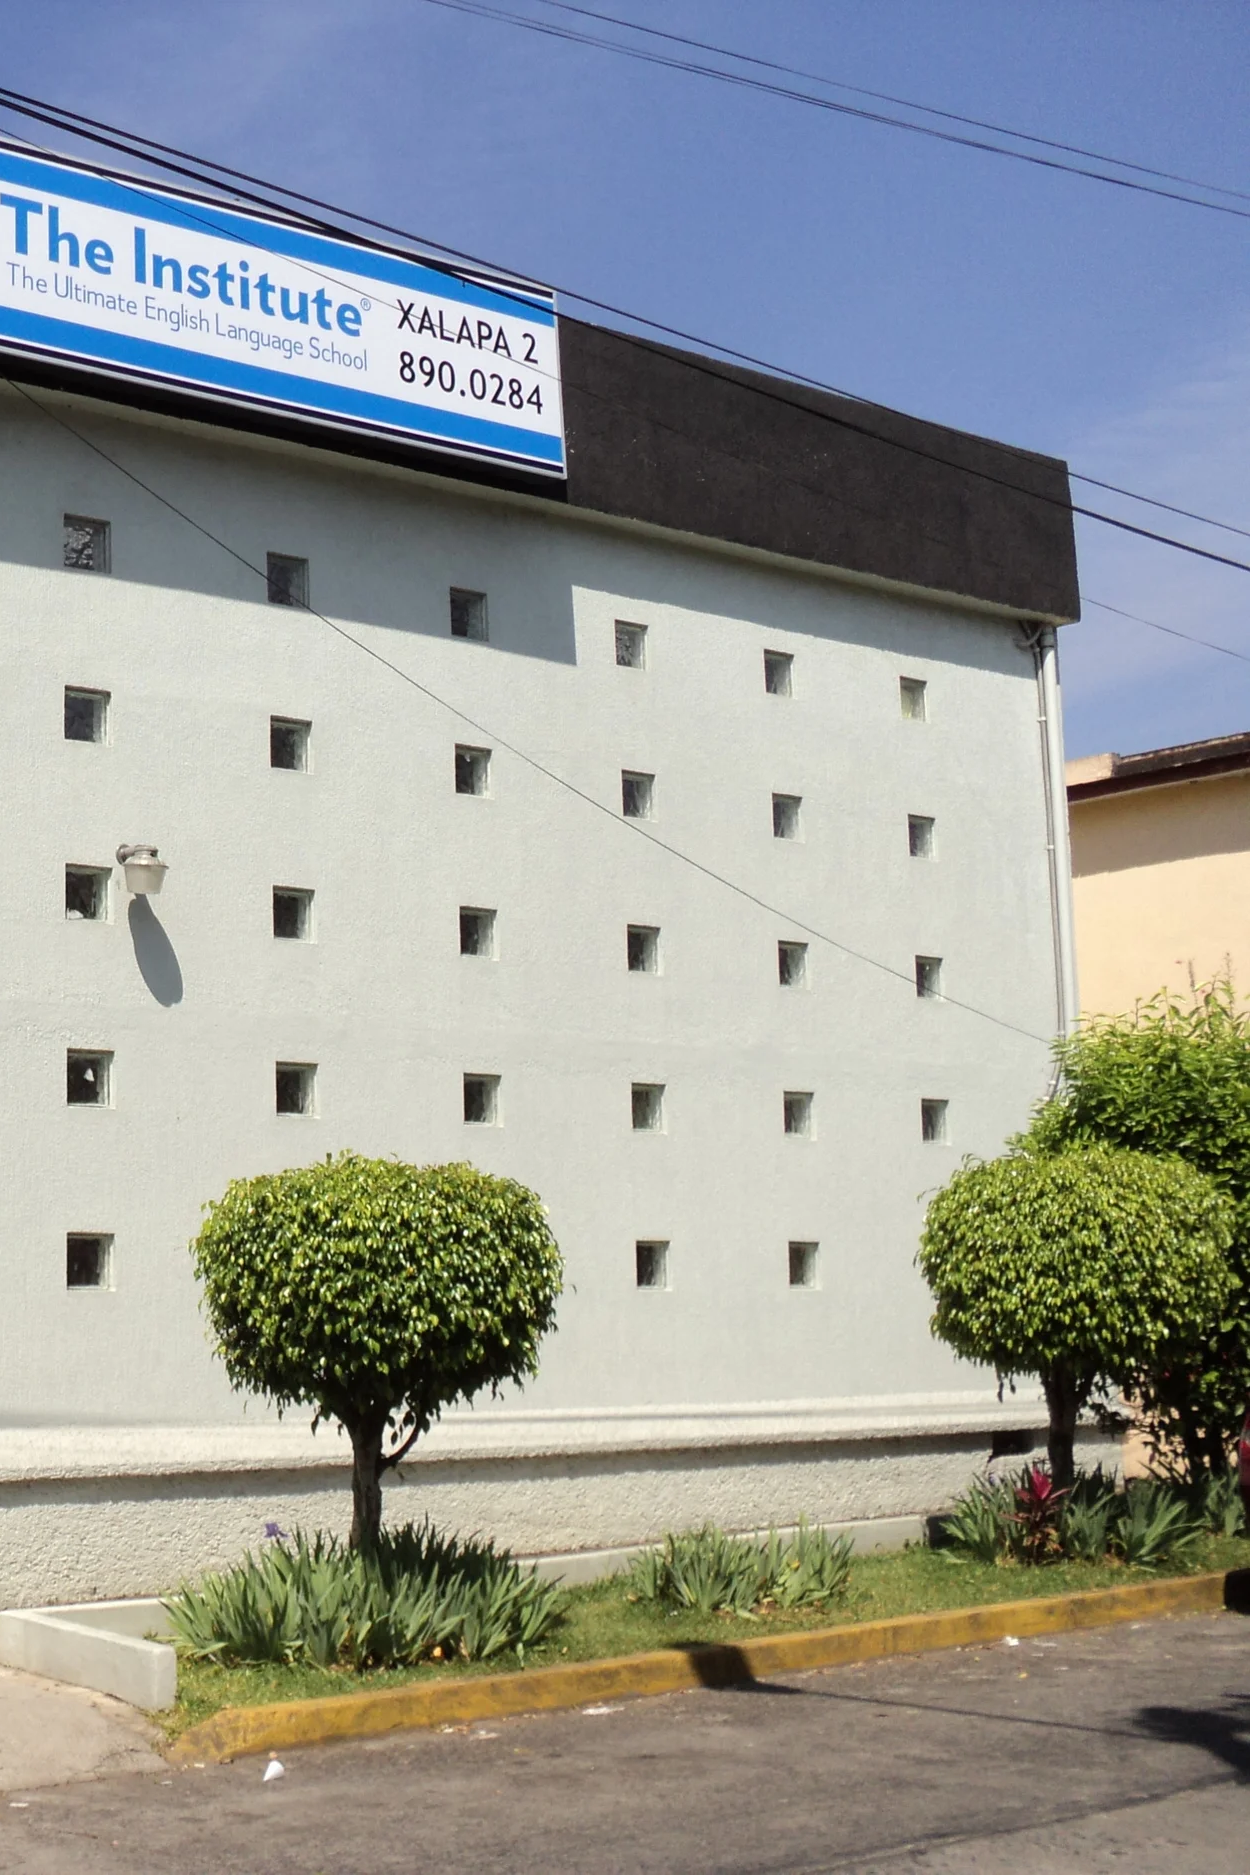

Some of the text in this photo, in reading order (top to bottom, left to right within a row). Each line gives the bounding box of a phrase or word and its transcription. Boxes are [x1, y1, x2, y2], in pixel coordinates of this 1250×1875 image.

[0, 192, 363, 338] The Institute
[6, 261, 369, 373] The Ultimate English Language School
[396, 298, 539, 365] XALAPA 2
[398, 350, 545, 416] 890.0284
